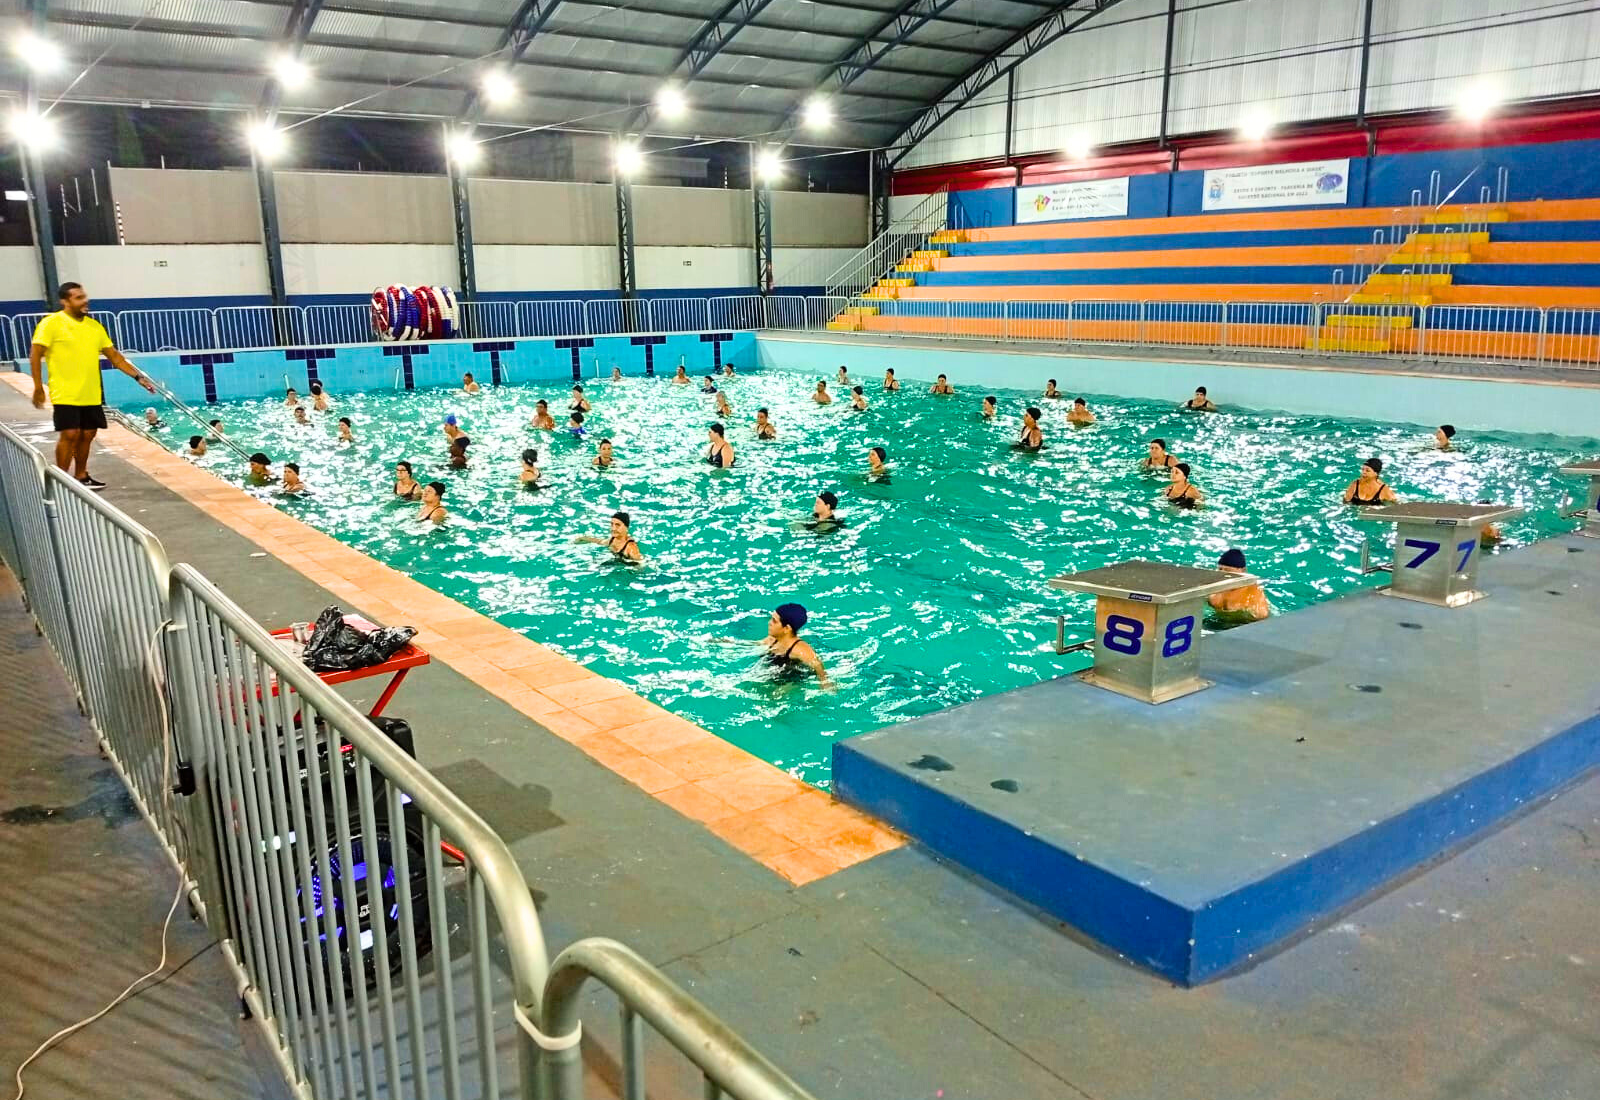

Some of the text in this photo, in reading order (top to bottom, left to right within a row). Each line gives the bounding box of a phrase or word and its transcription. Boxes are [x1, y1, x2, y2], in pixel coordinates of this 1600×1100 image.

[1405, 538, 1440, 569] 7
[1456, 538, 1477, 573] 7
[1104, 614, 1144, 655] 8
[1162, 615, 1195, 658] 8
